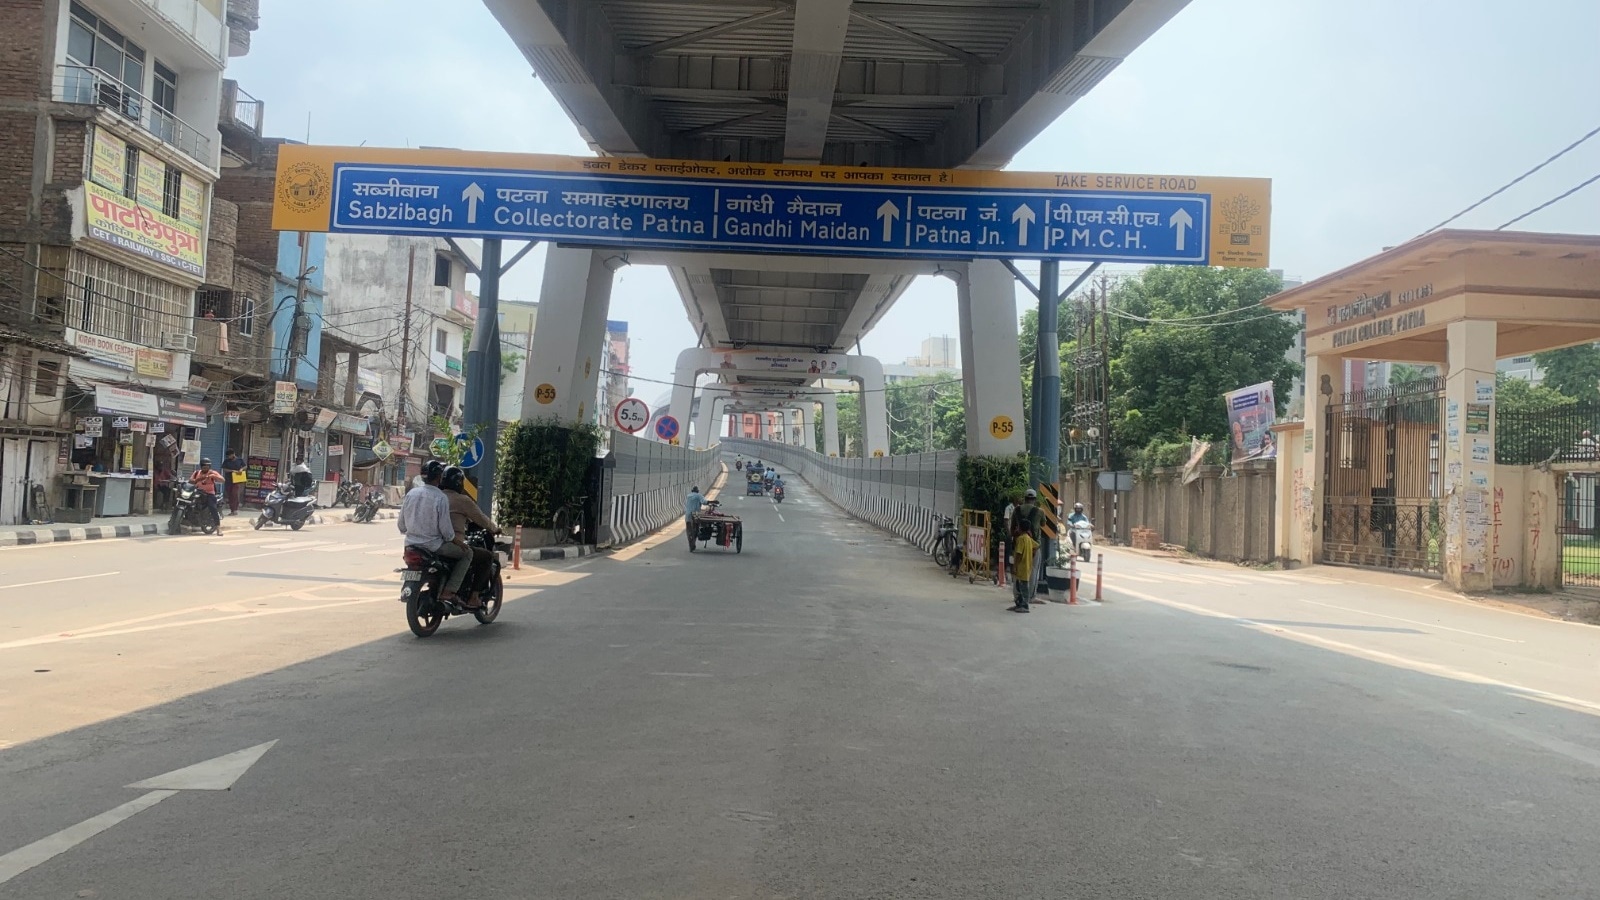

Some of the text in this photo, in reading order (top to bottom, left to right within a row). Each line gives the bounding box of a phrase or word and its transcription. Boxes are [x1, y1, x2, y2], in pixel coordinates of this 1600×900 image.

[582, 160, 612, 170] डबल
[618, 160, 647, 172] डेकर
[727, 164, 767, 177] अशोक
[773, 168, 813, 179] राजपथ
[820, 171, 836, 180] पर
[843, 171, 884, 182] आपका
[891, 173, 931, 183] स्वागत
[1054, 174, 1197, 191] TAKE SERVICE ROAD
[352, 178, 440, 199] सब्जीबाग
[496, 187, 691, 211] पटना समाहरणालय
[348, 200, 453, 226] Sabzibagh
[726, 193, 843, 217] गांधी मैदान
[917, 205, 968, 222] पटना
[1053, 203, 1163, 228] पी.एम.सी.एच.
[89, 193, 200, 256] पाटलिपुत्रा
[95, 218, 134, 239] कोचिंग
[493, 206, 706, 234] Collectorate Patna
[724, 216, 870, 241] Gandhi Maidan
[915, 223, 1005, 246] Patna Jn.
[1051, 229, 1148, 250] P.M.C.H.
[92, 227, 201, 274] CET RAILWAY SSC C-TET
[536, 388, 556, 400] P-55
[992, 421, 1014, 433] P-55
[967, 532, 985, 558] STOP
